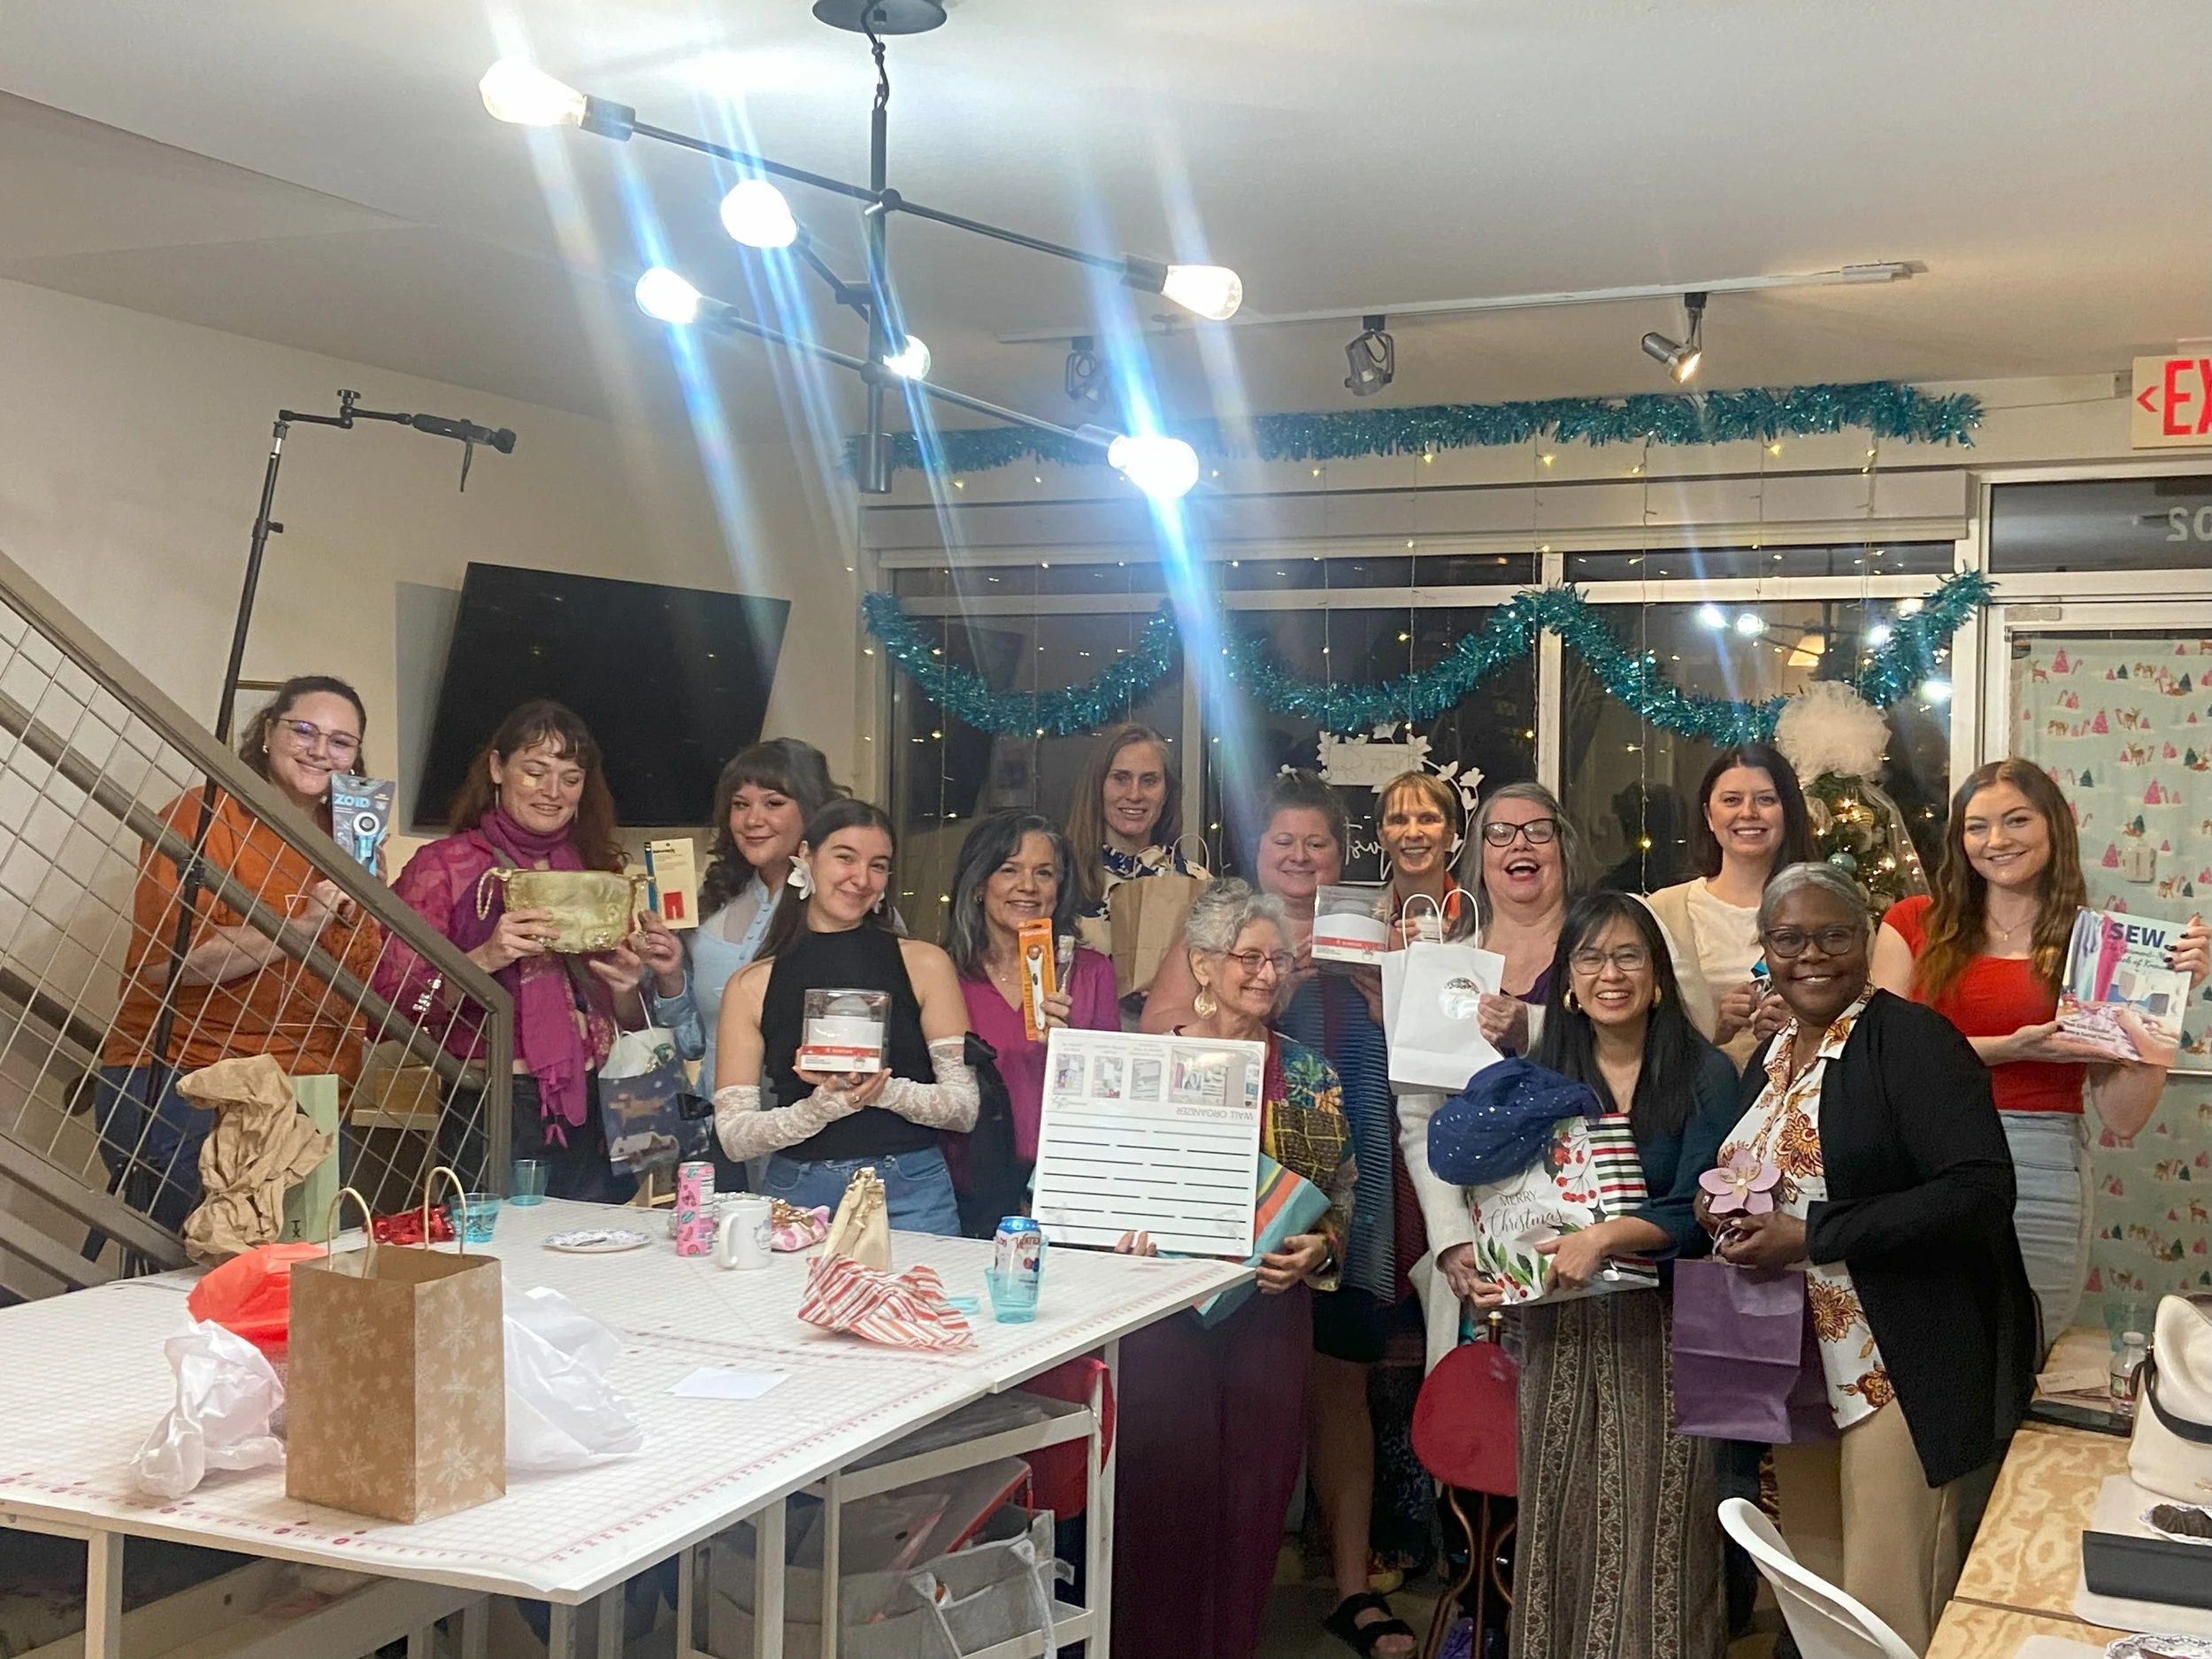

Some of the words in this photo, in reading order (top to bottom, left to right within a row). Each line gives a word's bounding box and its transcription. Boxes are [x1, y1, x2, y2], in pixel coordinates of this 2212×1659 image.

[2109, 922, 2166, 949] SEW
[1176, 1106, 1228, 1119] ORGANIZER
[1230, 1110, 1254, 1121] WALL
[1499, 1188, 1538, 1207] MERRY
[1486, 1208, 1563, 1238] Christmas
